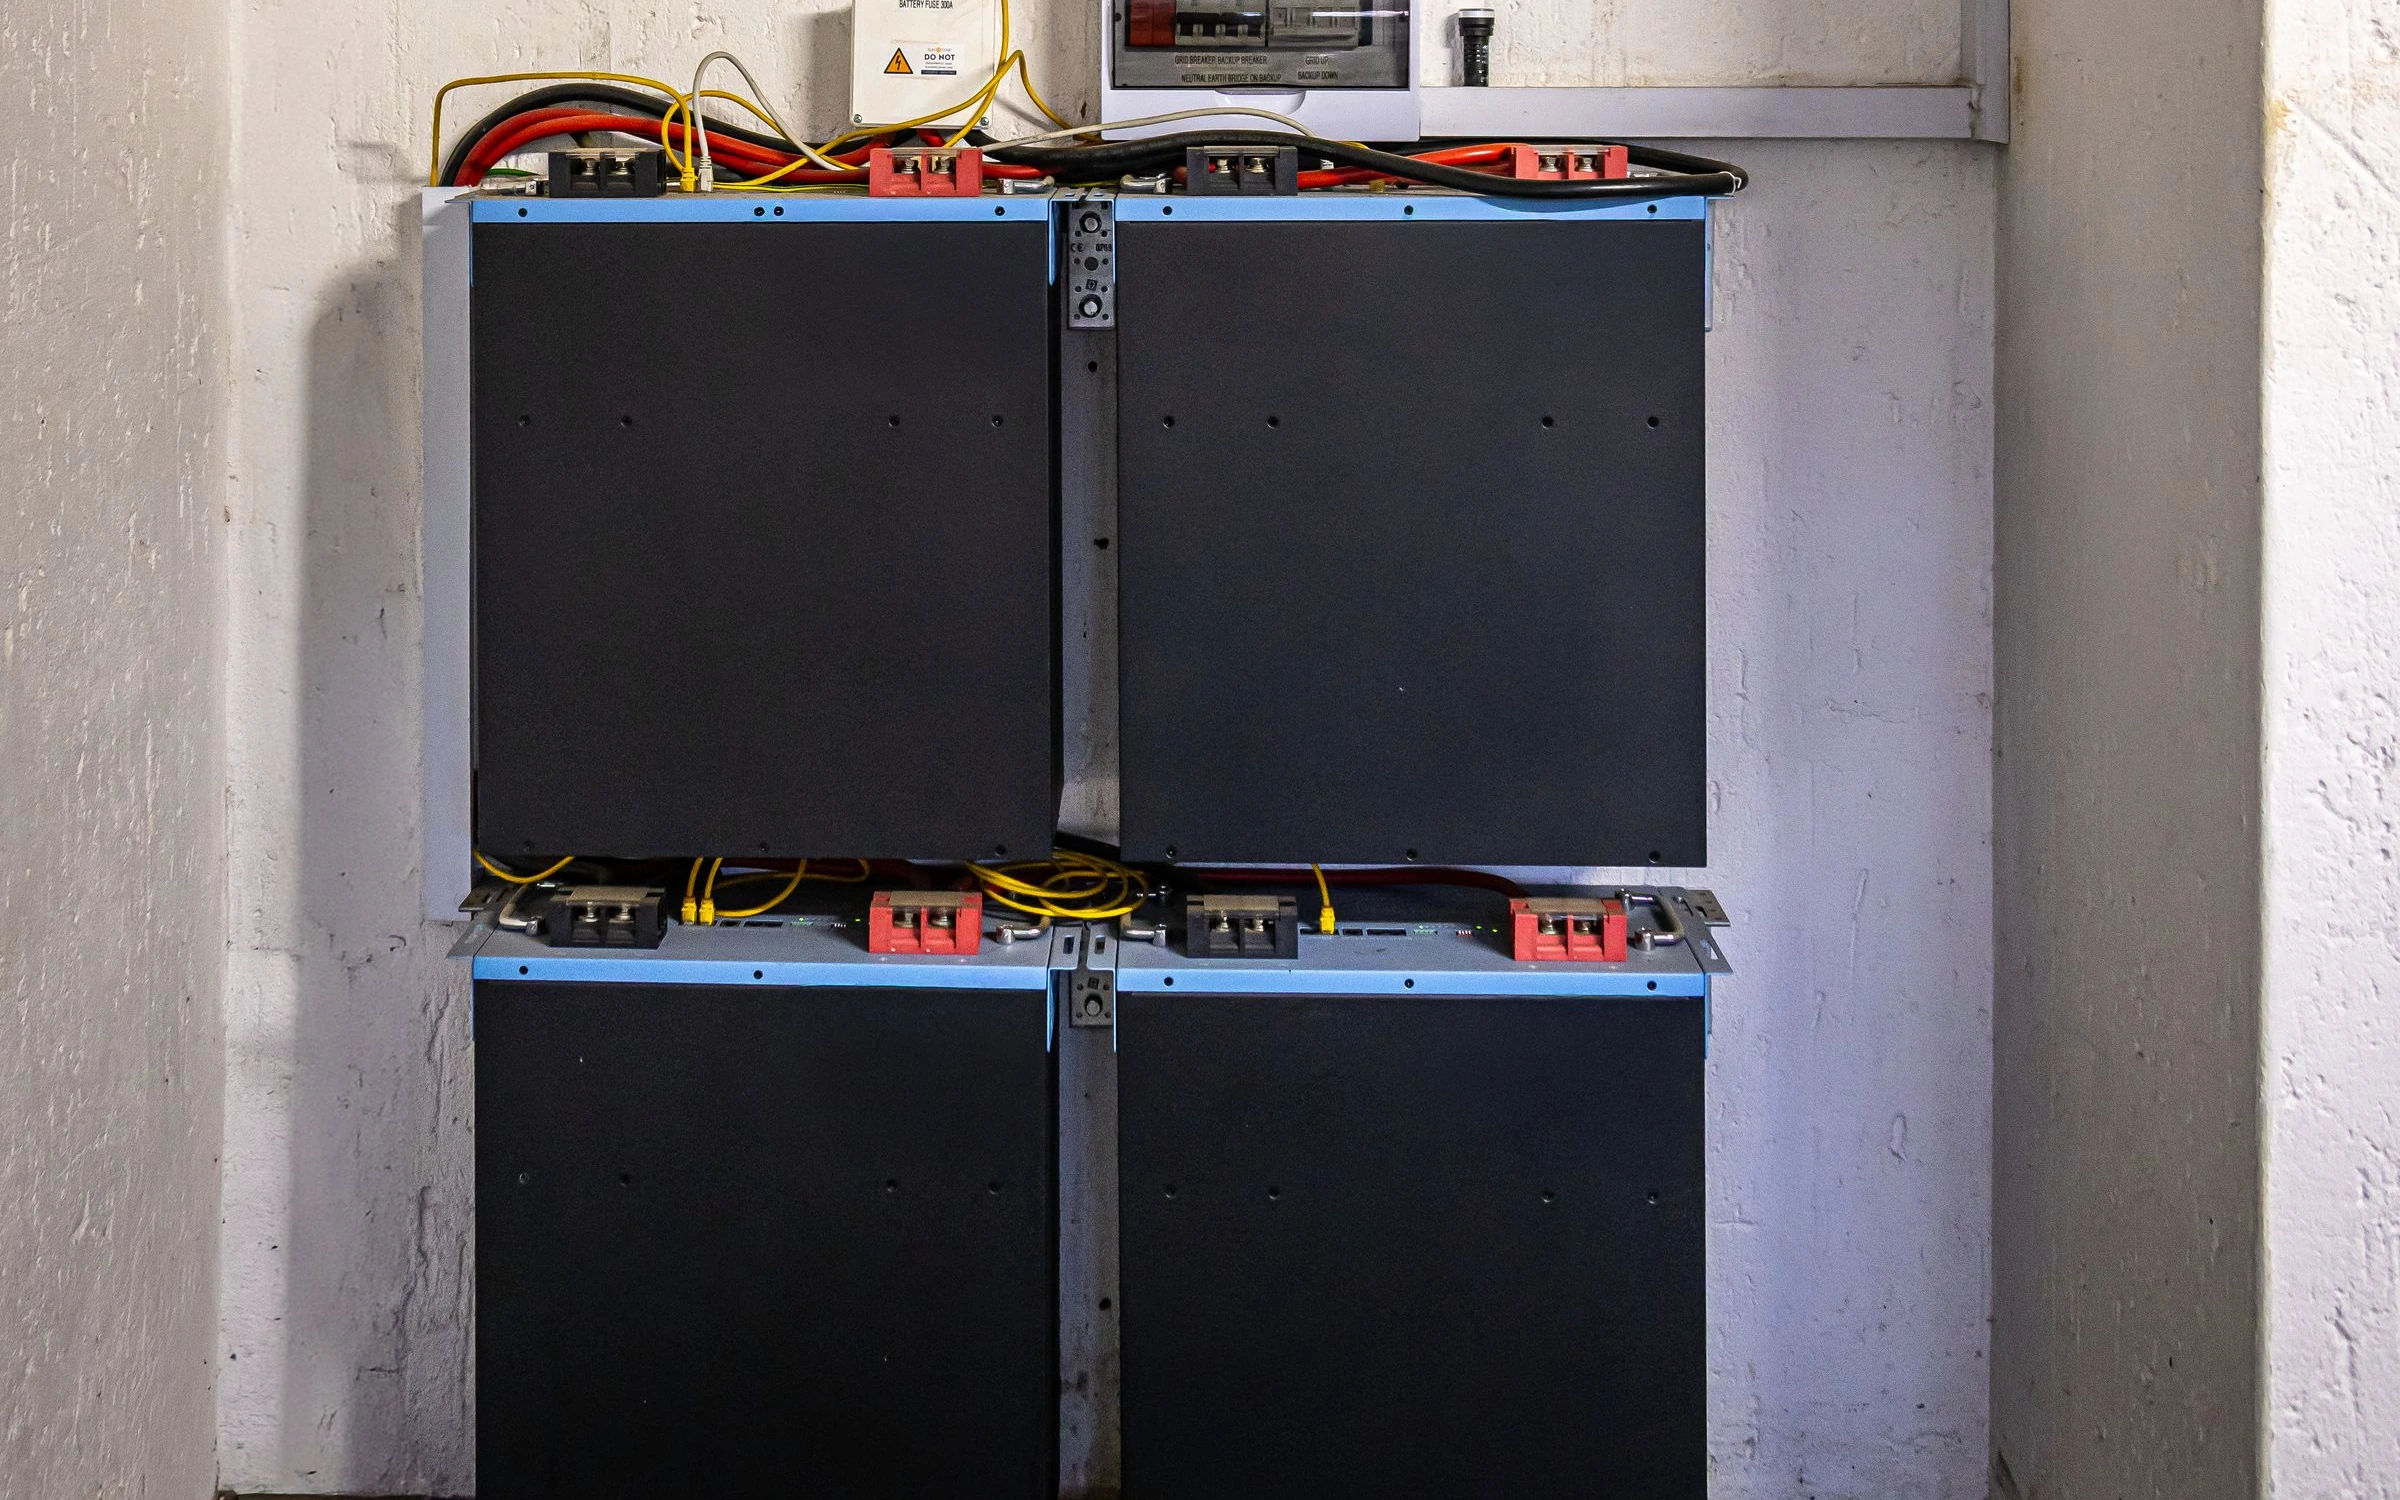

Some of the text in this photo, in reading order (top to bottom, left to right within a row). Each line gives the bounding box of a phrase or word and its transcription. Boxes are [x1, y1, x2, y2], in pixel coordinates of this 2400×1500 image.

[899, 0, 924, 8] BATTERY
[925, 0, 939, 8] FUSE
[1175, 55, 1267, 64] GRID BREAKER BACKUP BREAKER
[1306, 56, 1329, 64] GRID UP
[1182, 74, 1281, 82] NEUTRAL EARTH BRIDGE ON BACKUP
[1298, 71, 1338, 79] BACKUP DOWN
